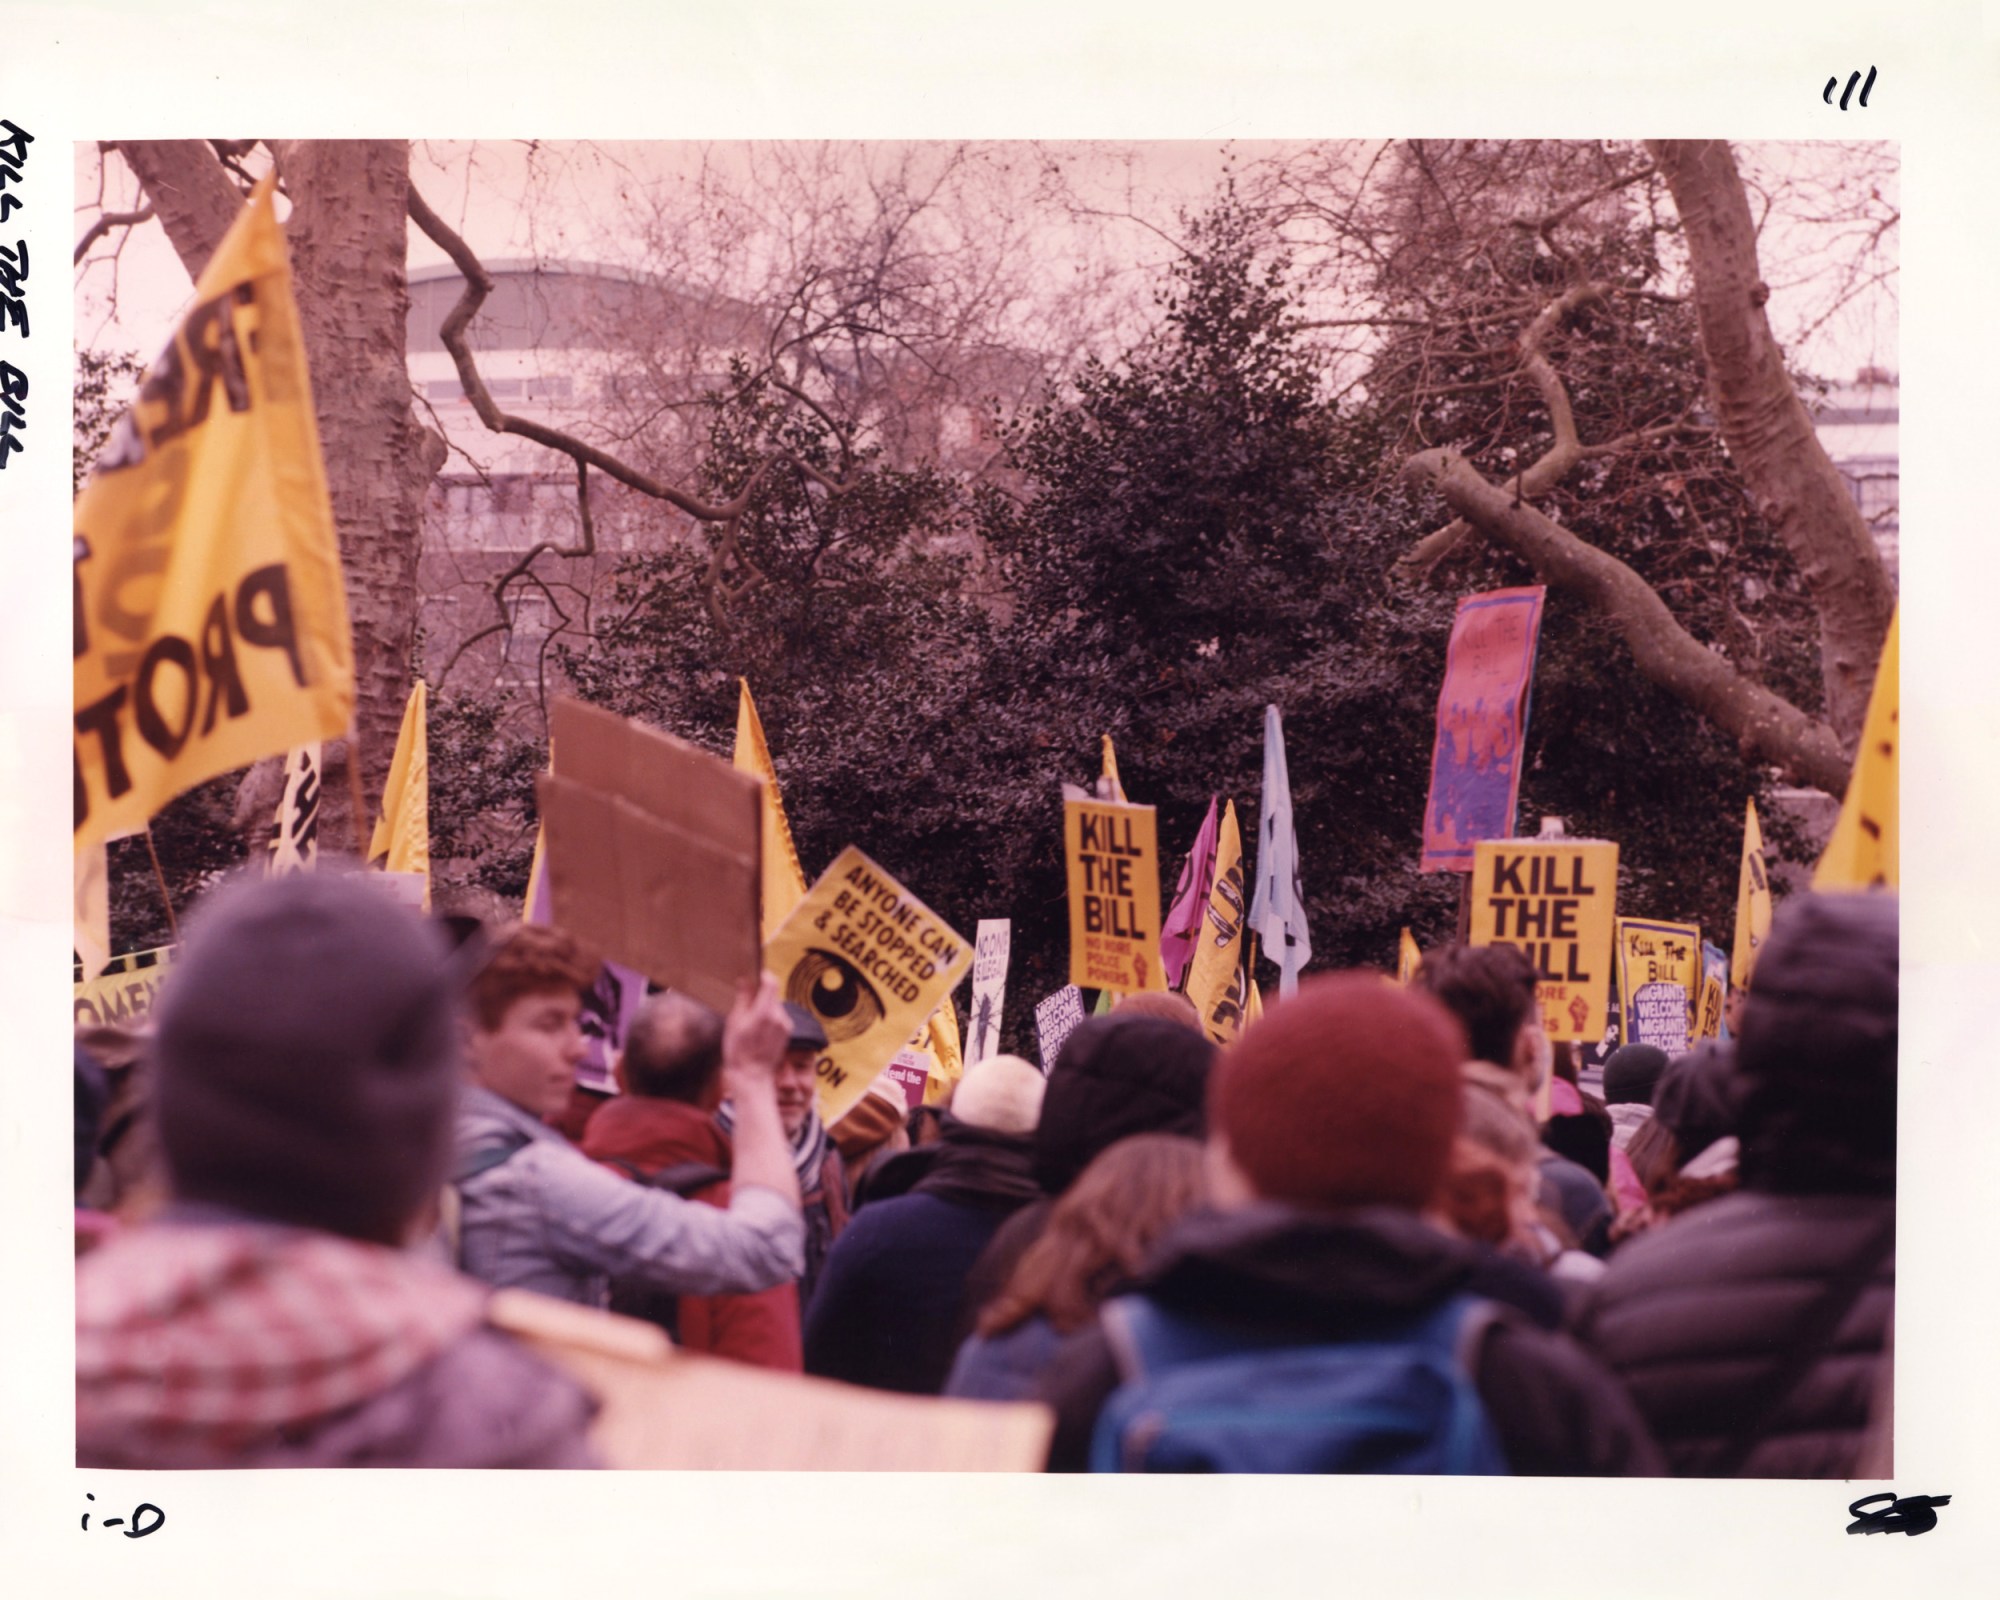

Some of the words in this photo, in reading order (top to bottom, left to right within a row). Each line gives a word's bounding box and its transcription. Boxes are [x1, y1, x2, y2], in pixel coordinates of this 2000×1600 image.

[0, 119, 35, 223] KILL
[0, 239, 30, 338] THE
[0, 360, 29, 470] BILL
[1080, 812, 1142, 857] KILL
[1078, 854, 1133, 897] THE
[1493, 855, 1595, 895] KILL
[833, 890, 862, 918] BE
[857, 911, 936, 980] STOPPED
[845, 866, 921, 933] ANYONE
[919, 928, 959, 965] CAN
[1083, 895, 1146, 940] BILL
[1489, 898, 1579, 938] THE
[814, 911, 832, 931] &
[831, 924, 920, 1003] SEARCHED
[1489, 941, 1590, 982] ILL
[1648, 960, 1678, 982] BILL
[1036, 985, 1079, 1022] MIGRANTS
[1535, 985, 1567, 1000] ORE
[1635, 983, 1686, 1001] MIGRANTS
[1637, 1000, 1687, 1018] WELCOME
[1038, 995, 1081, 1036] WELCOME
[1039, 1009, 1084, 1051] MIGRANTS
[1638, 1018, 1687, 1035] MIGRANTS
[907, 1071, 922, 1085] the
[81, 1492, 166, 1539] i-D
